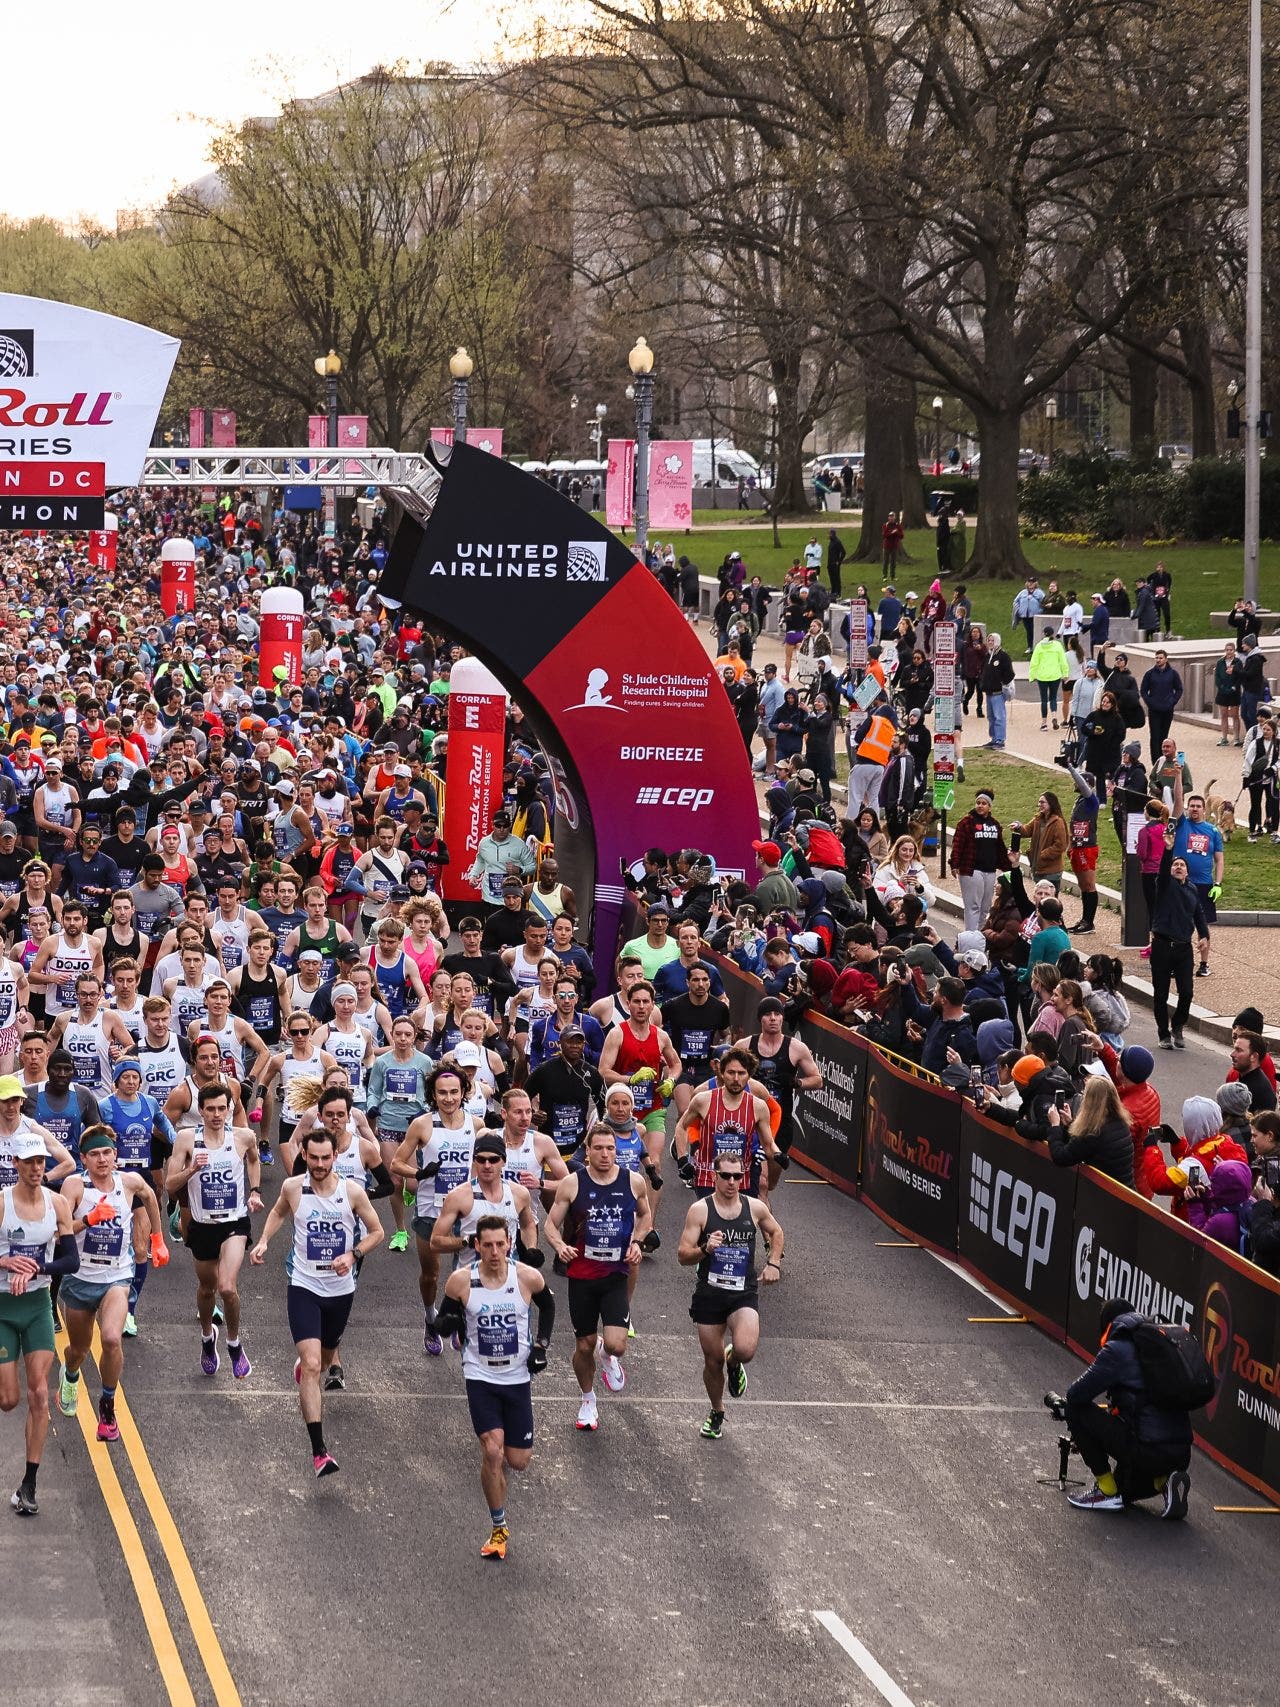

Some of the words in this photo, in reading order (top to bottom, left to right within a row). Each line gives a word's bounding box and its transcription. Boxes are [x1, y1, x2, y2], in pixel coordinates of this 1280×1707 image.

[49, 470, 92, 488] DC
[98, 535, 108, 547] 3
[457, 543, 558, 559] UNITED
[177, 567, 187, 581] 2
[429, 561, 558, 578] AIRLINES
[276, 614, 301, 622] CORRAL
[285, 622, 293, 640] 1
[622, 673, 635, 684] St.
[635, 674, 659, 685] Jude
[659, 674, 709, 687] Children's
[622, 685, 665, 696] Research
[667, 686, 708, 698] Hospital
[456, 695, 492, 705] CORRAL
[465, 706, 480, 729] E
[484, 752, 492, 788] SERIES
[662, 787, 715, 812] cep
[482, 788, 490, 837] ARATHON
[55, 959, 90, 971] DOJO
[251, 1010, 269, 1018] 1072
[68, 1042, 96, 1055] GRC
[335, 1047, 361, 1059] GRC
[687, 1041, 704, 1051] 1318
[76, 1069, 95, 1077] 1019
[145, 1068, 176, 1083] GRC
[827, 1060, 855, 1094] Children's
[630, 1085, 648, 1094] 1016
[828, 1093, 853, 1122] Hospital
[558, 1117, 579, 1126] 2863
[437, 1150, 470, 1165] GRC
[199, 1169, 234, 1185] GRC
[882, 1154, 911, 1185] RUNNING
[911, 1173, 942, 1201] SERIES
[306, 1220, 344, 1234] GRC
[991, 1169, 1057, 1291] cep
[97, 1243, 108, 1251] 34
[598, 1237, 609, 1245] 48
[320, 1248, 333, 1257] 40
[723, 1263, 734, 1272] 42
[1094, 1246, 1195, 1331] ENDURANCE
[477, 1313, 517, 1329] GRC
[492, 1344, 504, 1353] 36
